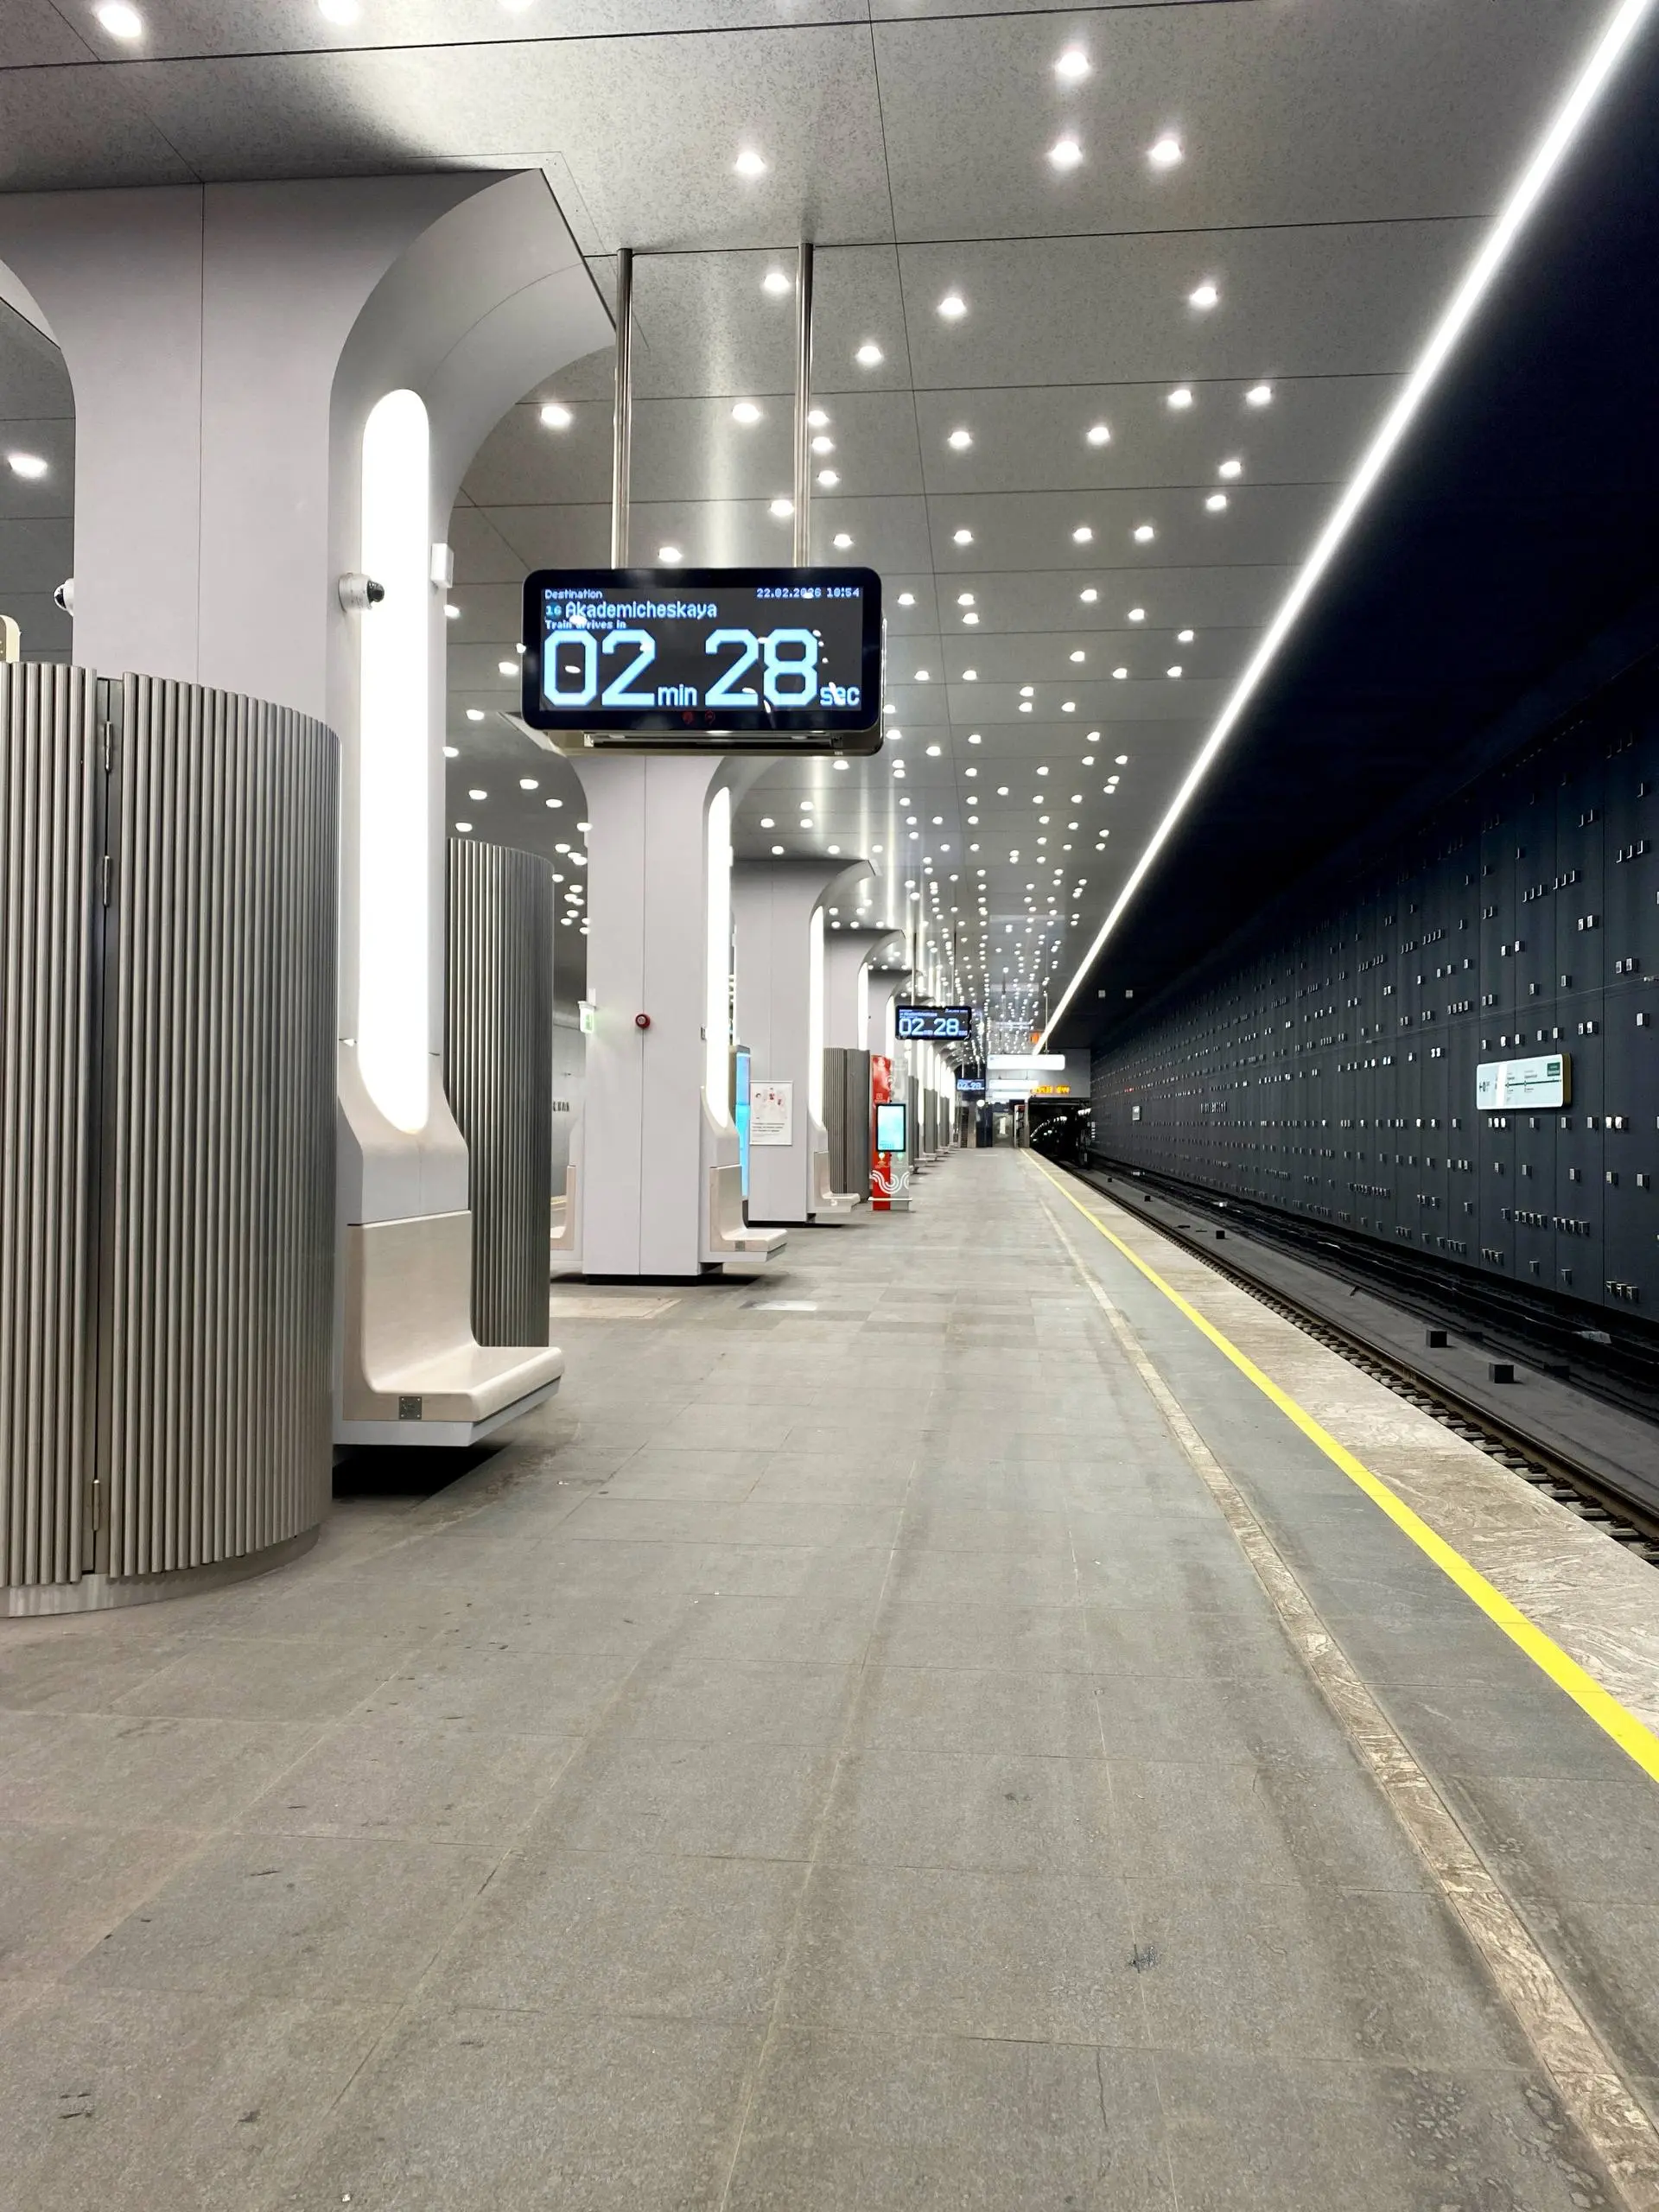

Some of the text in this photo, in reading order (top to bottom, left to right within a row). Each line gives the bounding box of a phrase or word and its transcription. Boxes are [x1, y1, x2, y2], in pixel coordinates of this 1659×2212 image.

[544, 589, 602, 599] Destination
[545, 601, 716, 620] 16 Akademicheskaya
[545, 620, 572, 629] Train
[616, 620, 626, 629] in
[543, 629, 860, 706] 02 min 28 sec
[899, 1018, 959, 1036] 02 28
